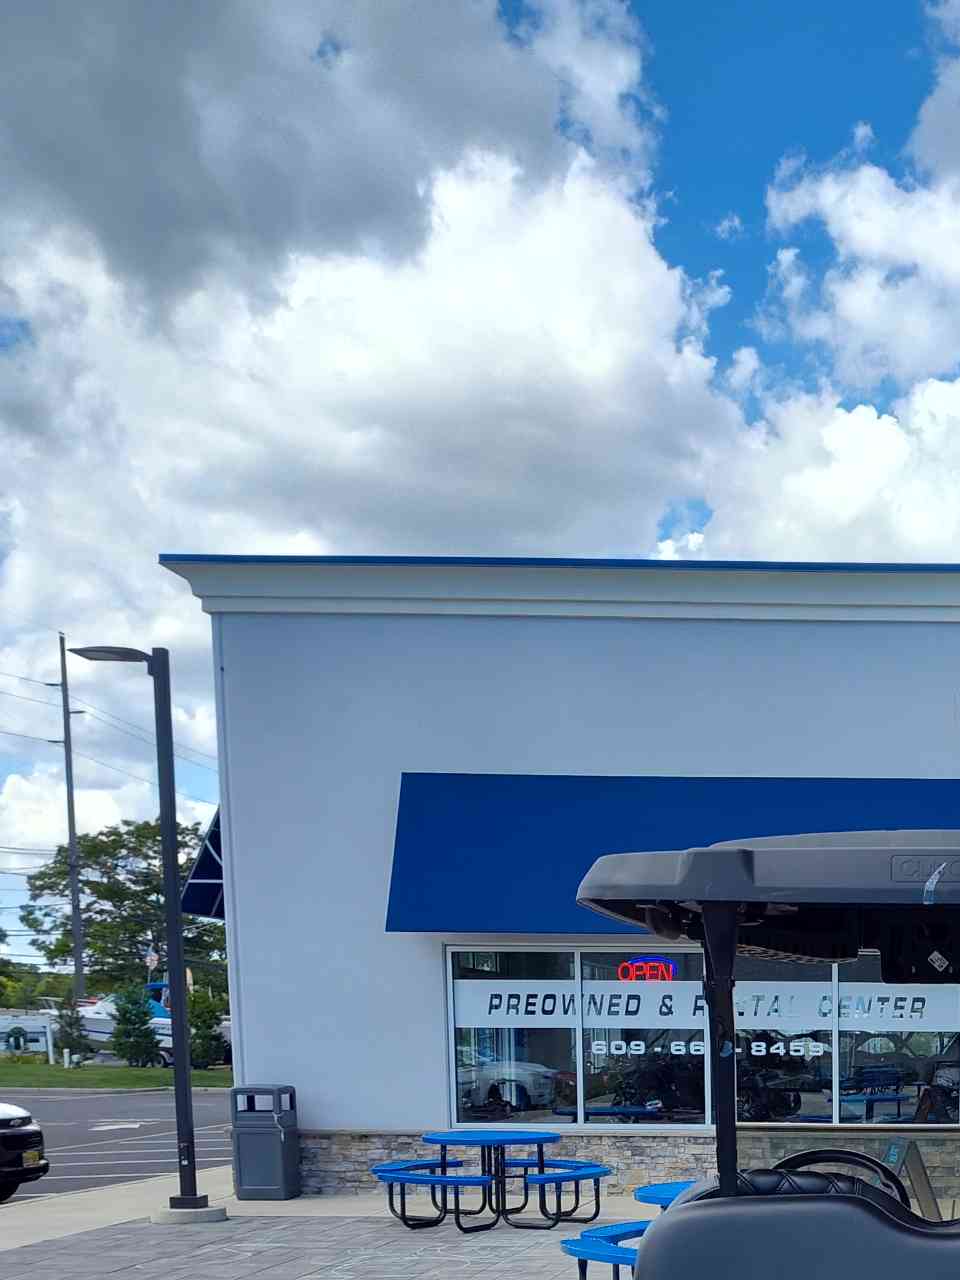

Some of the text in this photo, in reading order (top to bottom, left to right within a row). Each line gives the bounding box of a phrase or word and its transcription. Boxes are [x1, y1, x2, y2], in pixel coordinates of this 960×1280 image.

[616, 960, 673, 981] OPEN
[488, 993, 641, 1016] PREOWNED
[658, 995, 674, 1016] &
[817, 996, 926, 1019] CENTER
